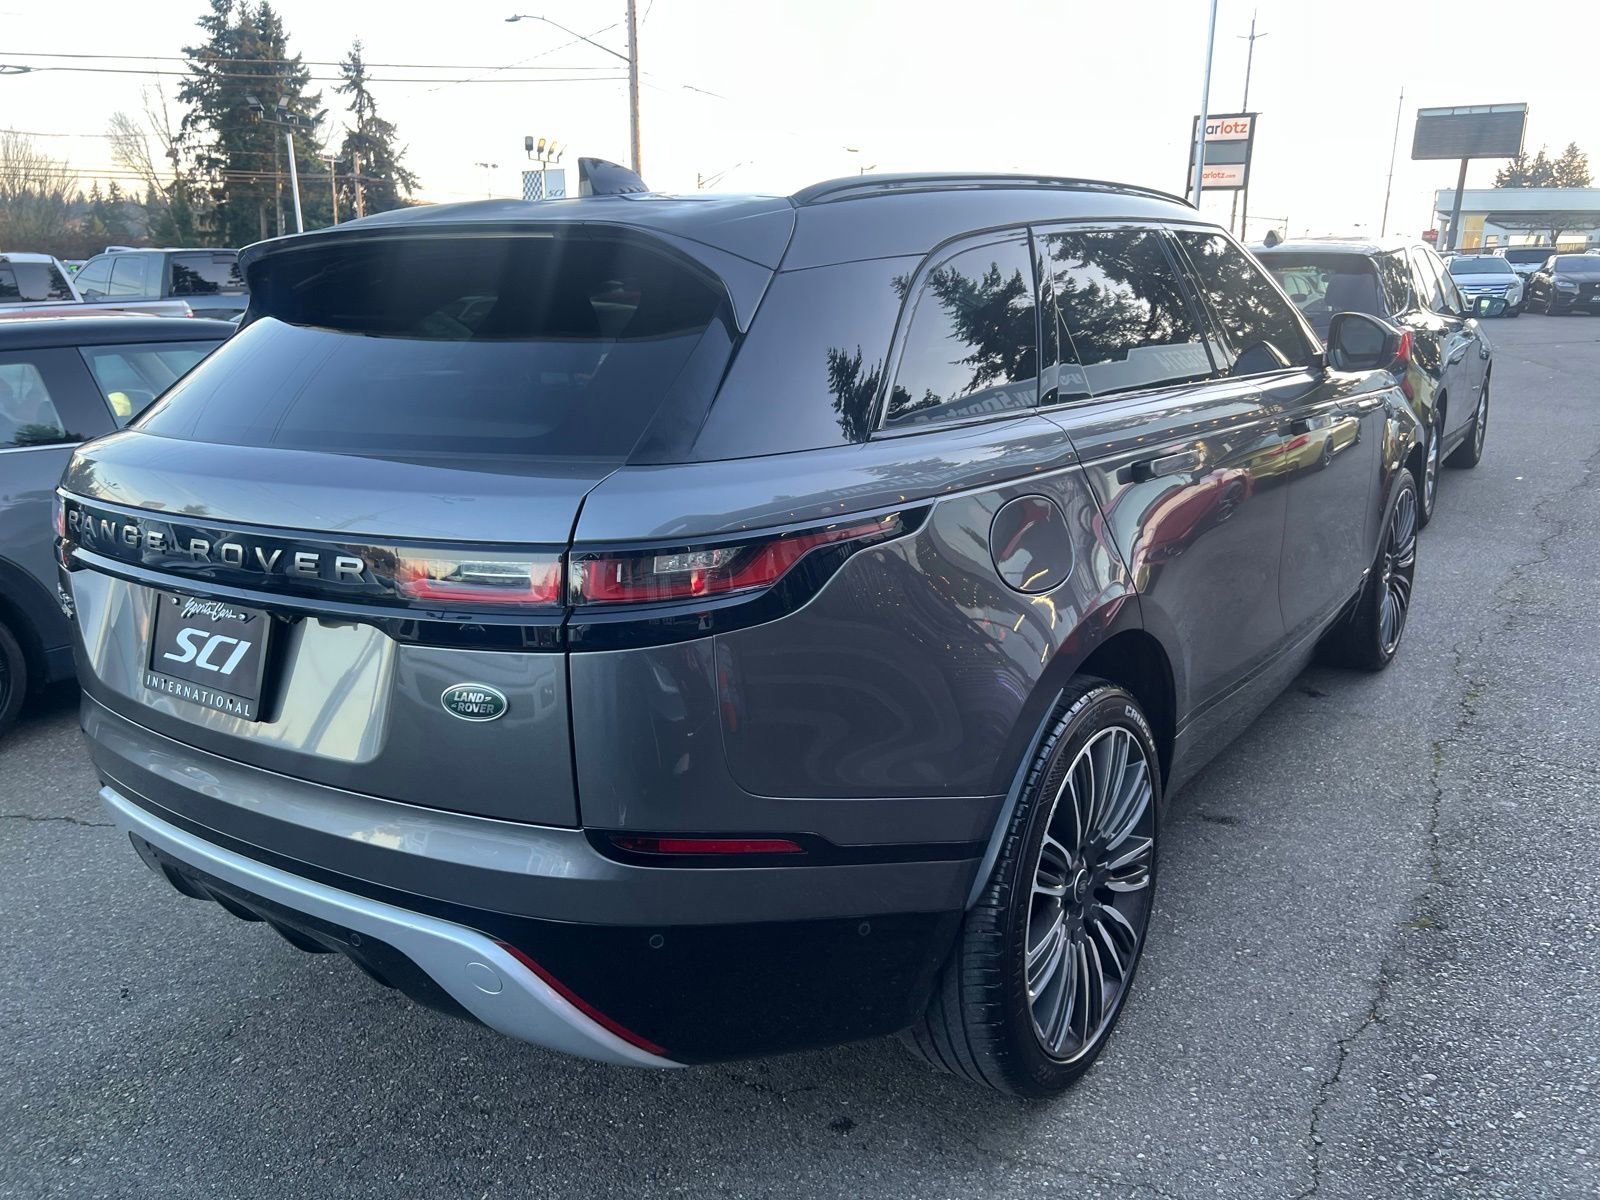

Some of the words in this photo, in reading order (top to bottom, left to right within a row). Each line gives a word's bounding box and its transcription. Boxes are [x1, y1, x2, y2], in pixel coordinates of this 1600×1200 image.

[1198, 121, 1248, 135] arlotz
[1202, 171, 1236, 179] arlotz.com
[68, 509, 165, 551] RANGE
[190, 537, 367, 583] ROVER
[163, 627, 252, 675] SCI
[146, 674, 251, 717] INTERNATIONAL
[454, 692, 485, 703] LAND
[457, 702, 495, 713] ROVER
